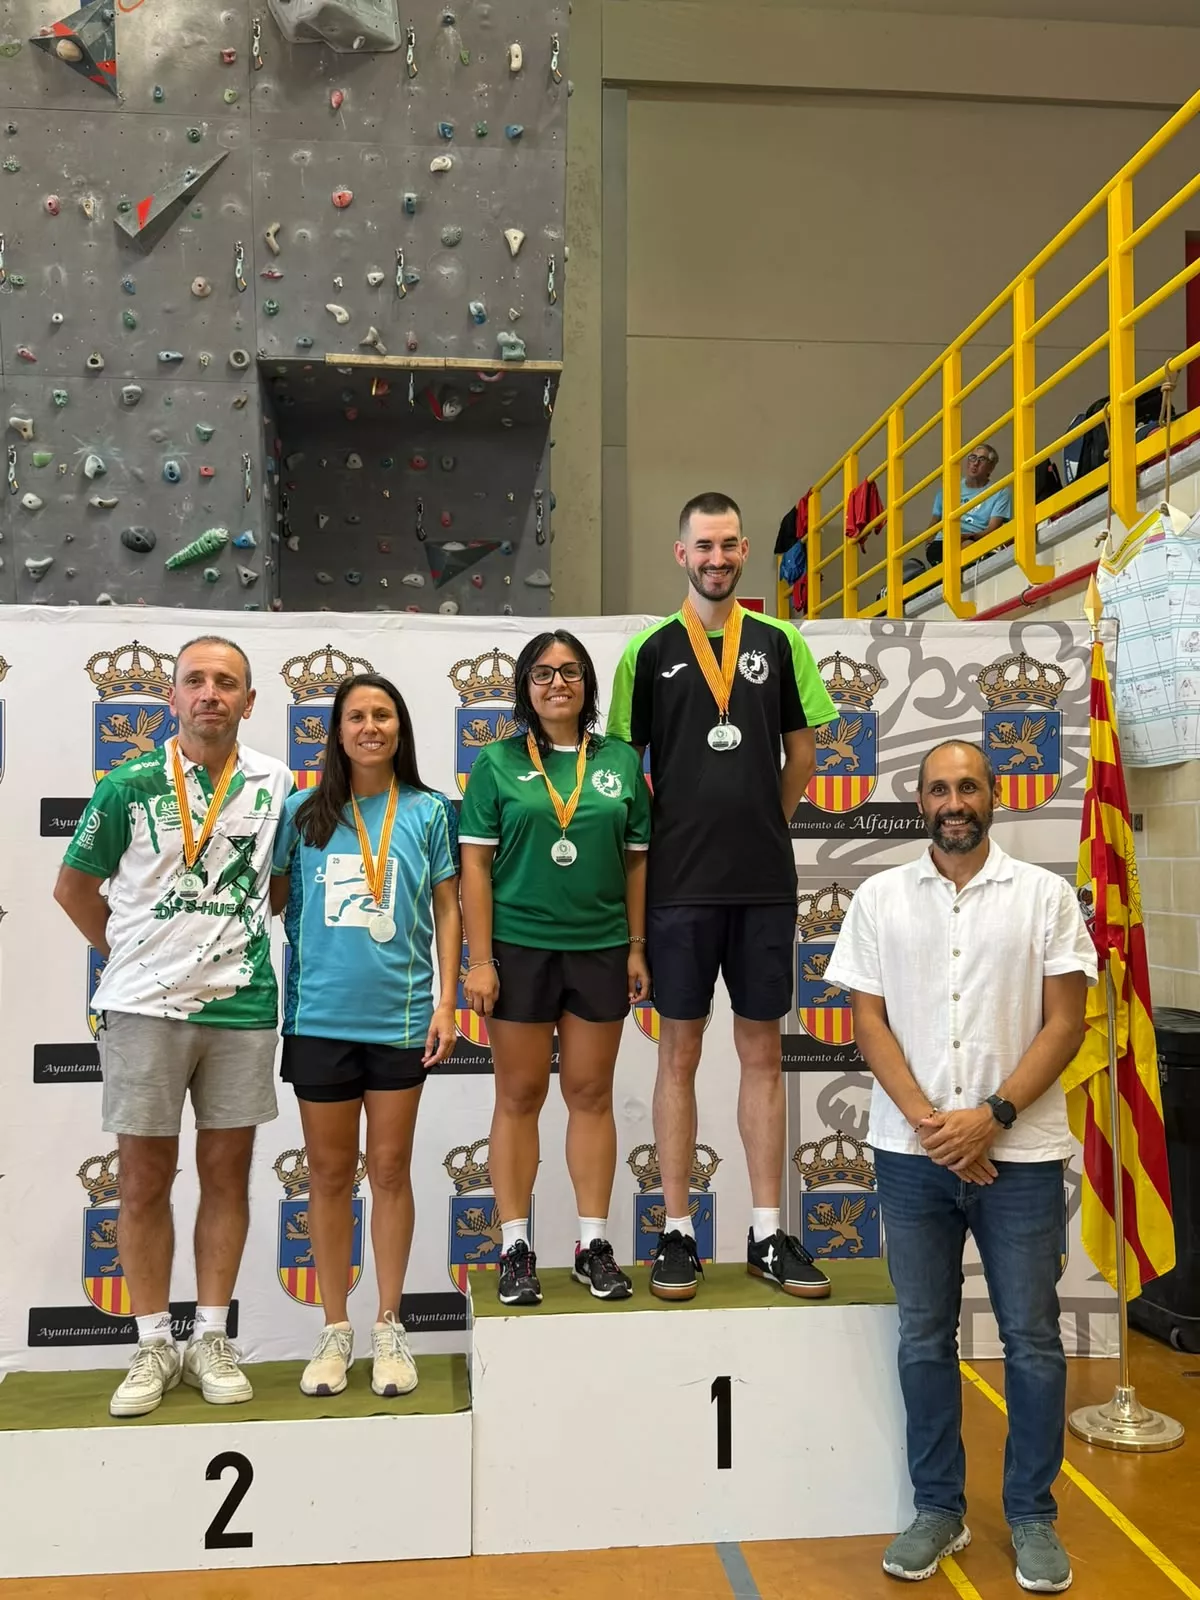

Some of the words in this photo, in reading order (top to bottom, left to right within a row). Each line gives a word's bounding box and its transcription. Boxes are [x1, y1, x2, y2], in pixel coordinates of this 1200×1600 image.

[787, 819, 832, 830] tamiento
[833, 819, 846, 830] de
[780, 1053, 832, 1063] ntamiento
[833, 1051, 846, 1063] de
[405, 1311, 466, 1325] Ayuntamie
[36, 1325, 118, 1338] Ayuntamiento
[120, 1324, 133, 1335] de
[711, 1375, 732, 1470] 1
[204, 1450, 254, 1550] 2
